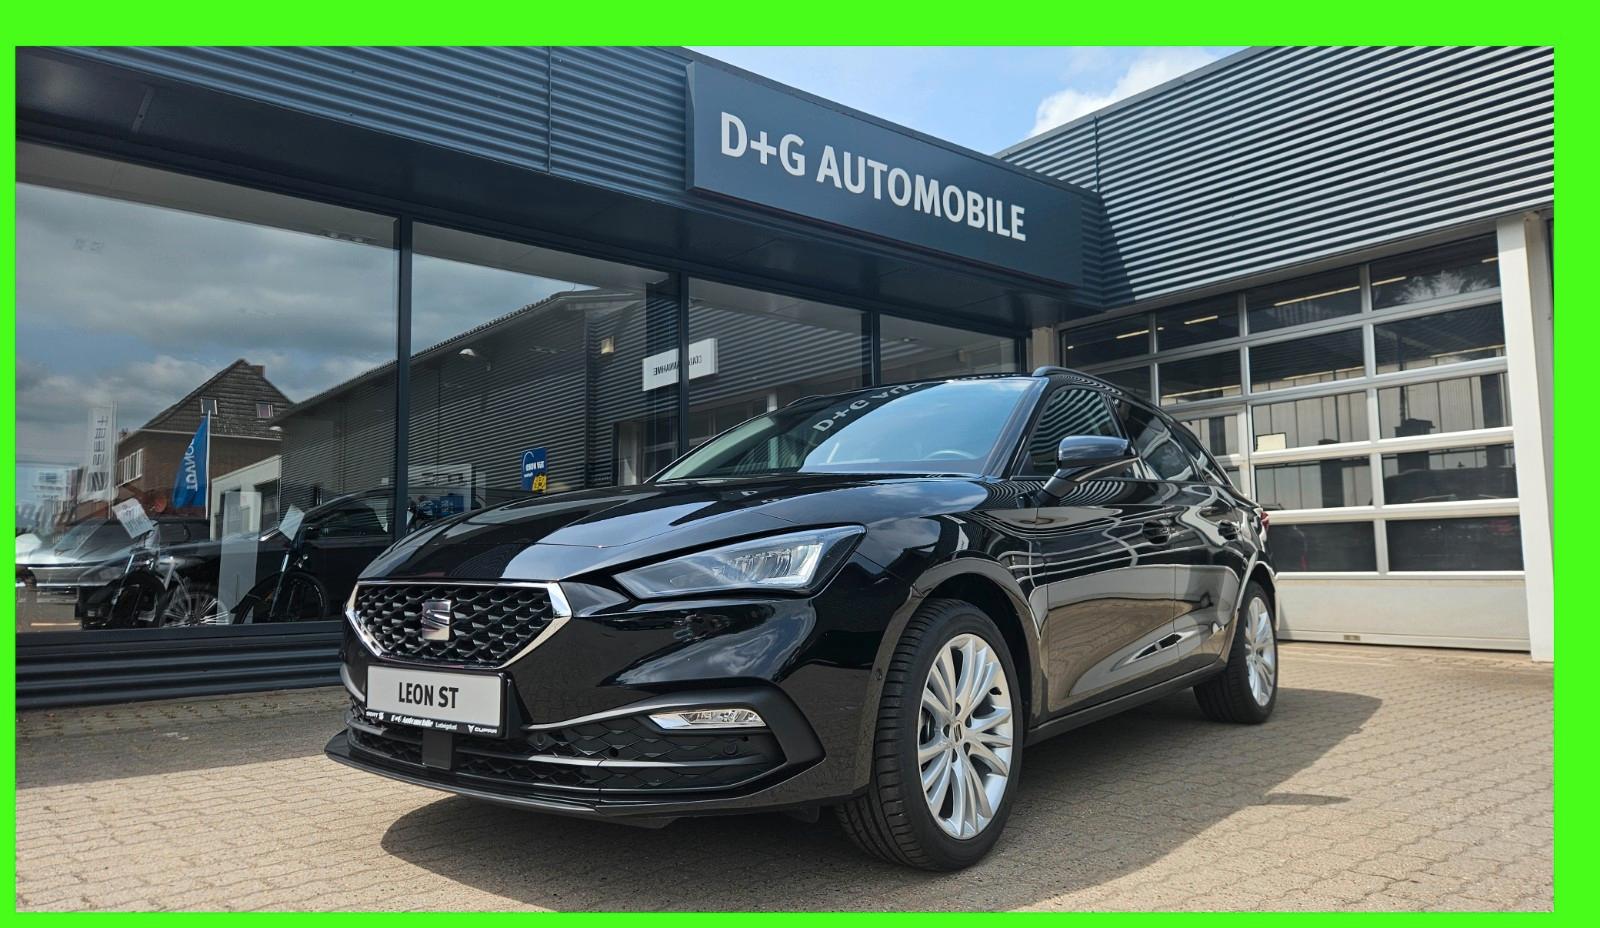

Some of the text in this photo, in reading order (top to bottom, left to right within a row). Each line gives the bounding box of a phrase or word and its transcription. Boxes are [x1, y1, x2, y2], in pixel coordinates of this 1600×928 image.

[721, 111, 1027, 242] D+G AUTOMOBILE
[398, 681, 459, 709] LEON ST
